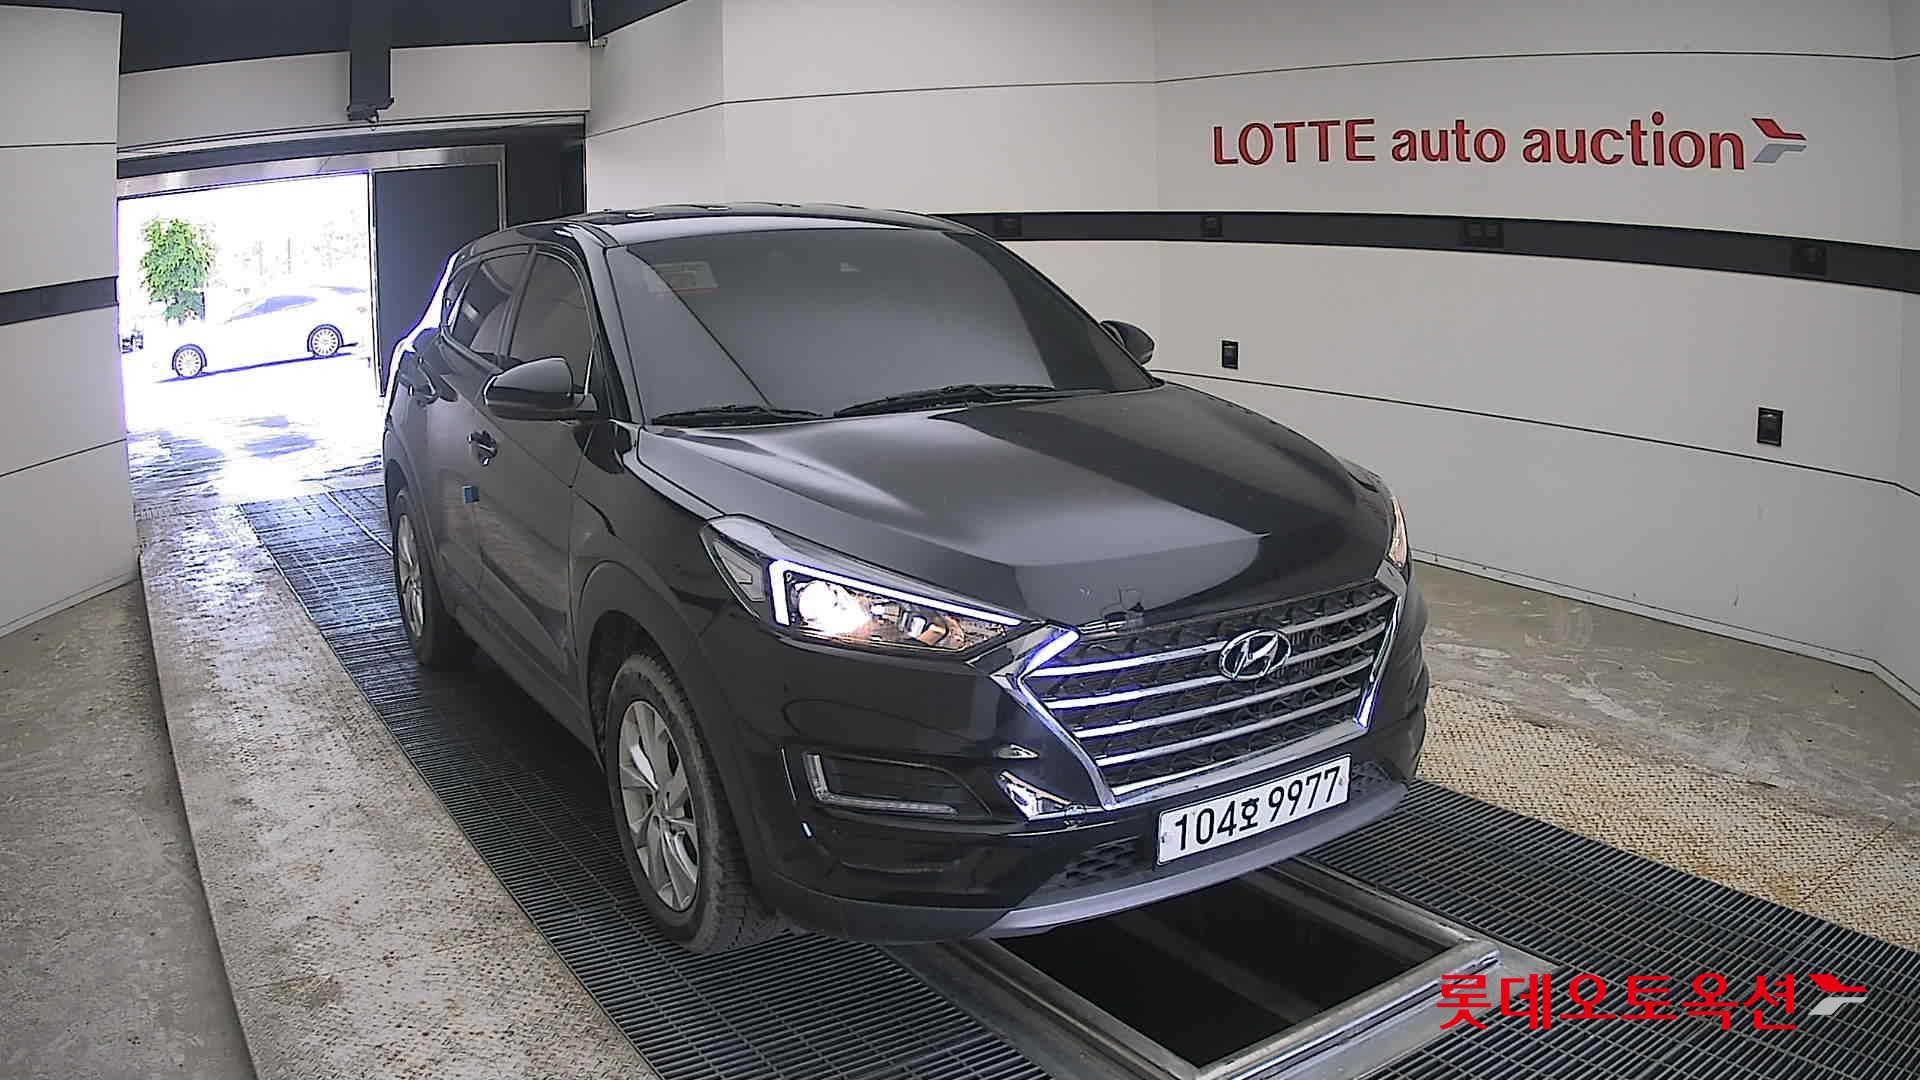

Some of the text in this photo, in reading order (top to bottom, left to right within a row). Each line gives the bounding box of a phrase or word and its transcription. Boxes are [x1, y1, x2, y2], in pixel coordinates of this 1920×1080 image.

[1213, 111, 1746, 170] LOTTE auto auction
[1267, 766, 1341, 823] 9977
